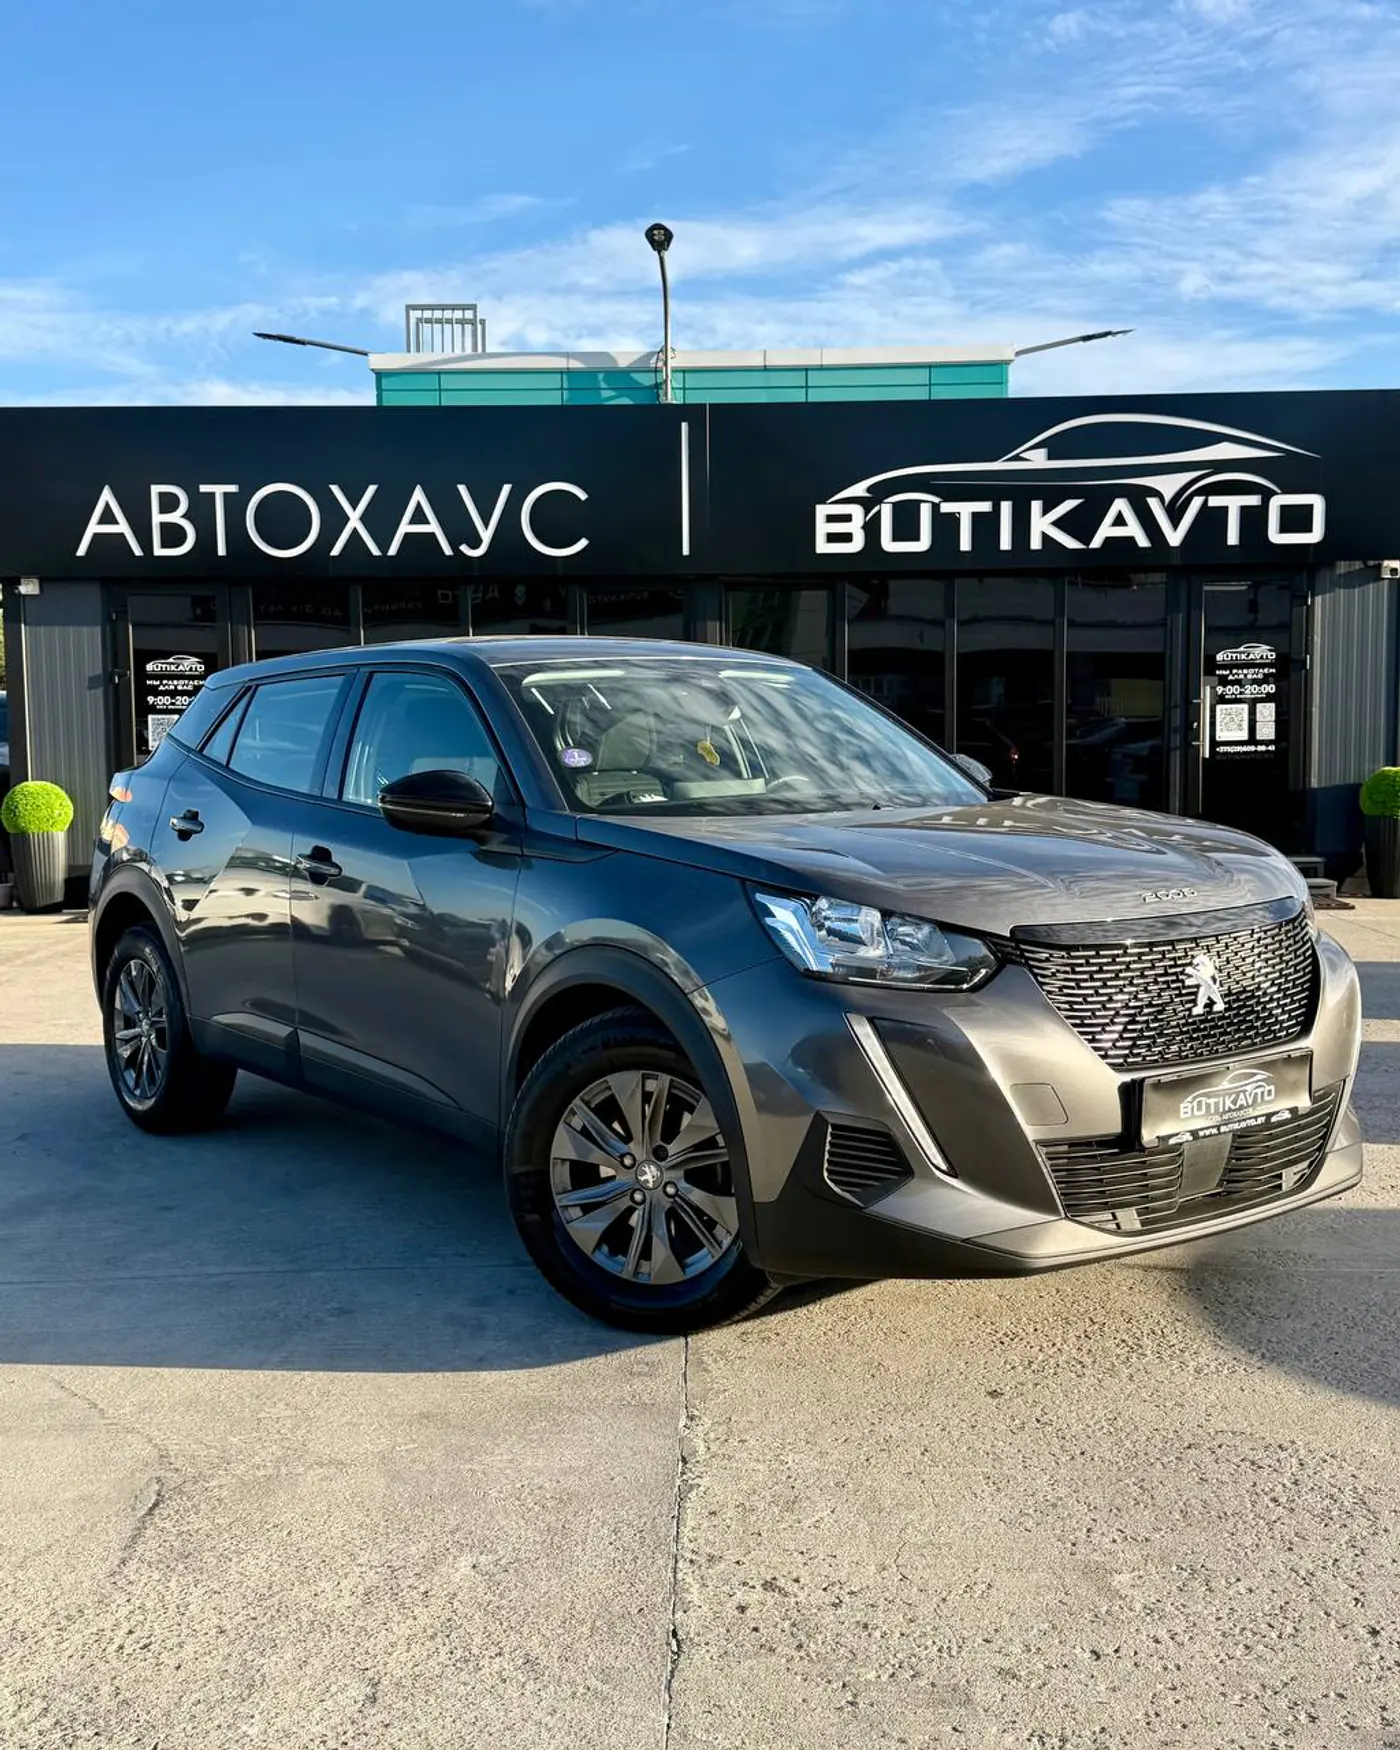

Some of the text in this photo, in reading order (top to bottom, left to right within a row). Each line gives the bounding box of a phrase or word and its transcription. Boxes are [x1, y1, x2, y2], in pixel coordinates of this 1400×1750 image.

[76, 481, 590, 559] АВТОХАУС
[814, 493, 1326, 555] BUTIKAVTO
[1216, 684, 1276, 695] 9:00-20:00
[1180, 1085, 1276, 1119] BUTIKAVTO
